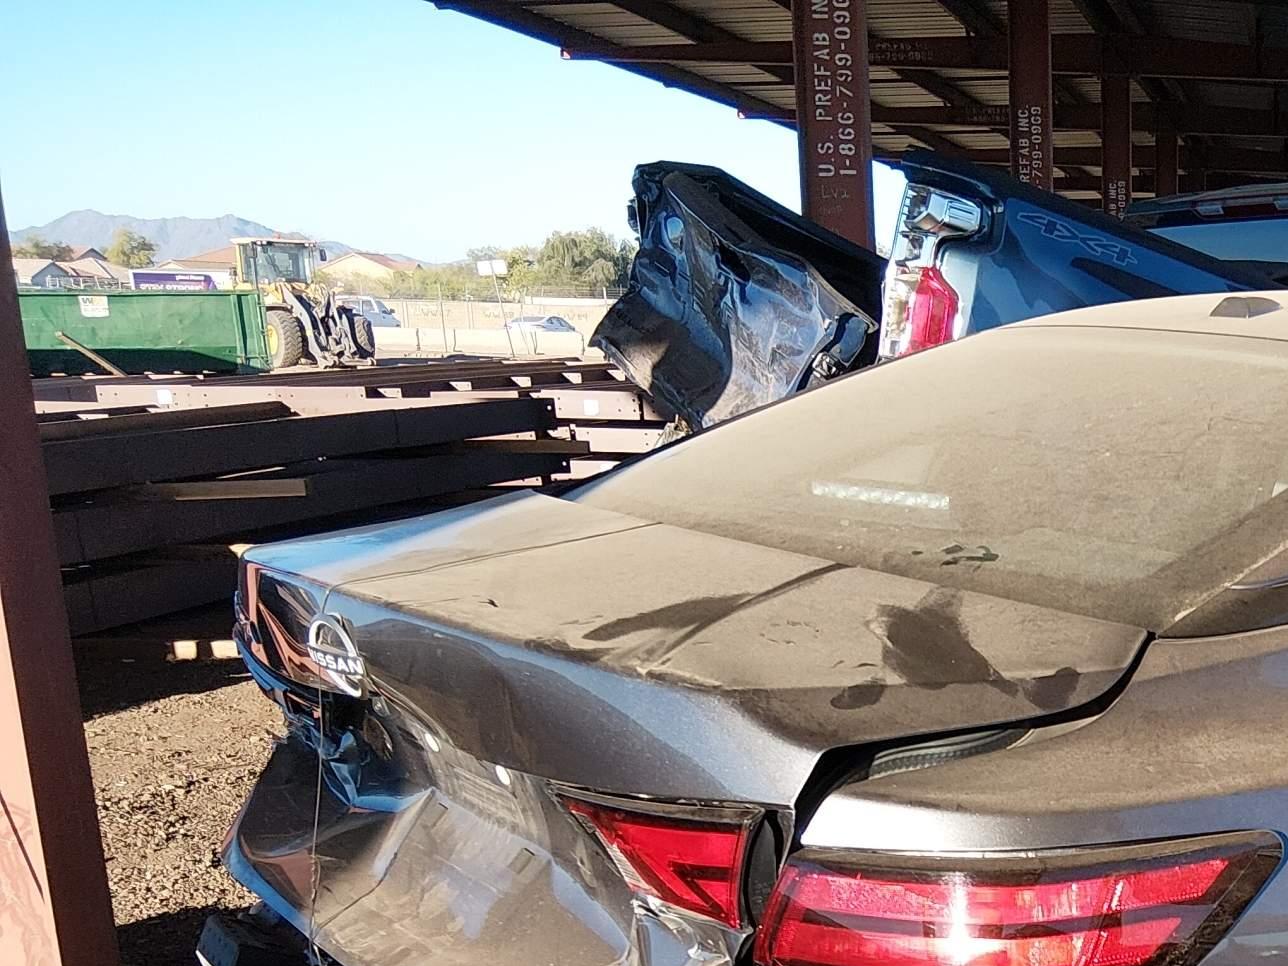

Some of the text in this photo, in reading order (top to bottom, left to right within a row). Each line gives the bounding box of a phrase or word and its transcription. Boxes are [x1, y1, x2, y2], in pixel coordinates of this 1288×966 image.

[811, 32, 833, 122] PREFAB
[1018, 104, 1029, 131] INC.
[816, 135, 836, 177] U.S.
[1031, 106, 1043, 189] -799-0969
[306, 646, 364, 675] NISSAN
